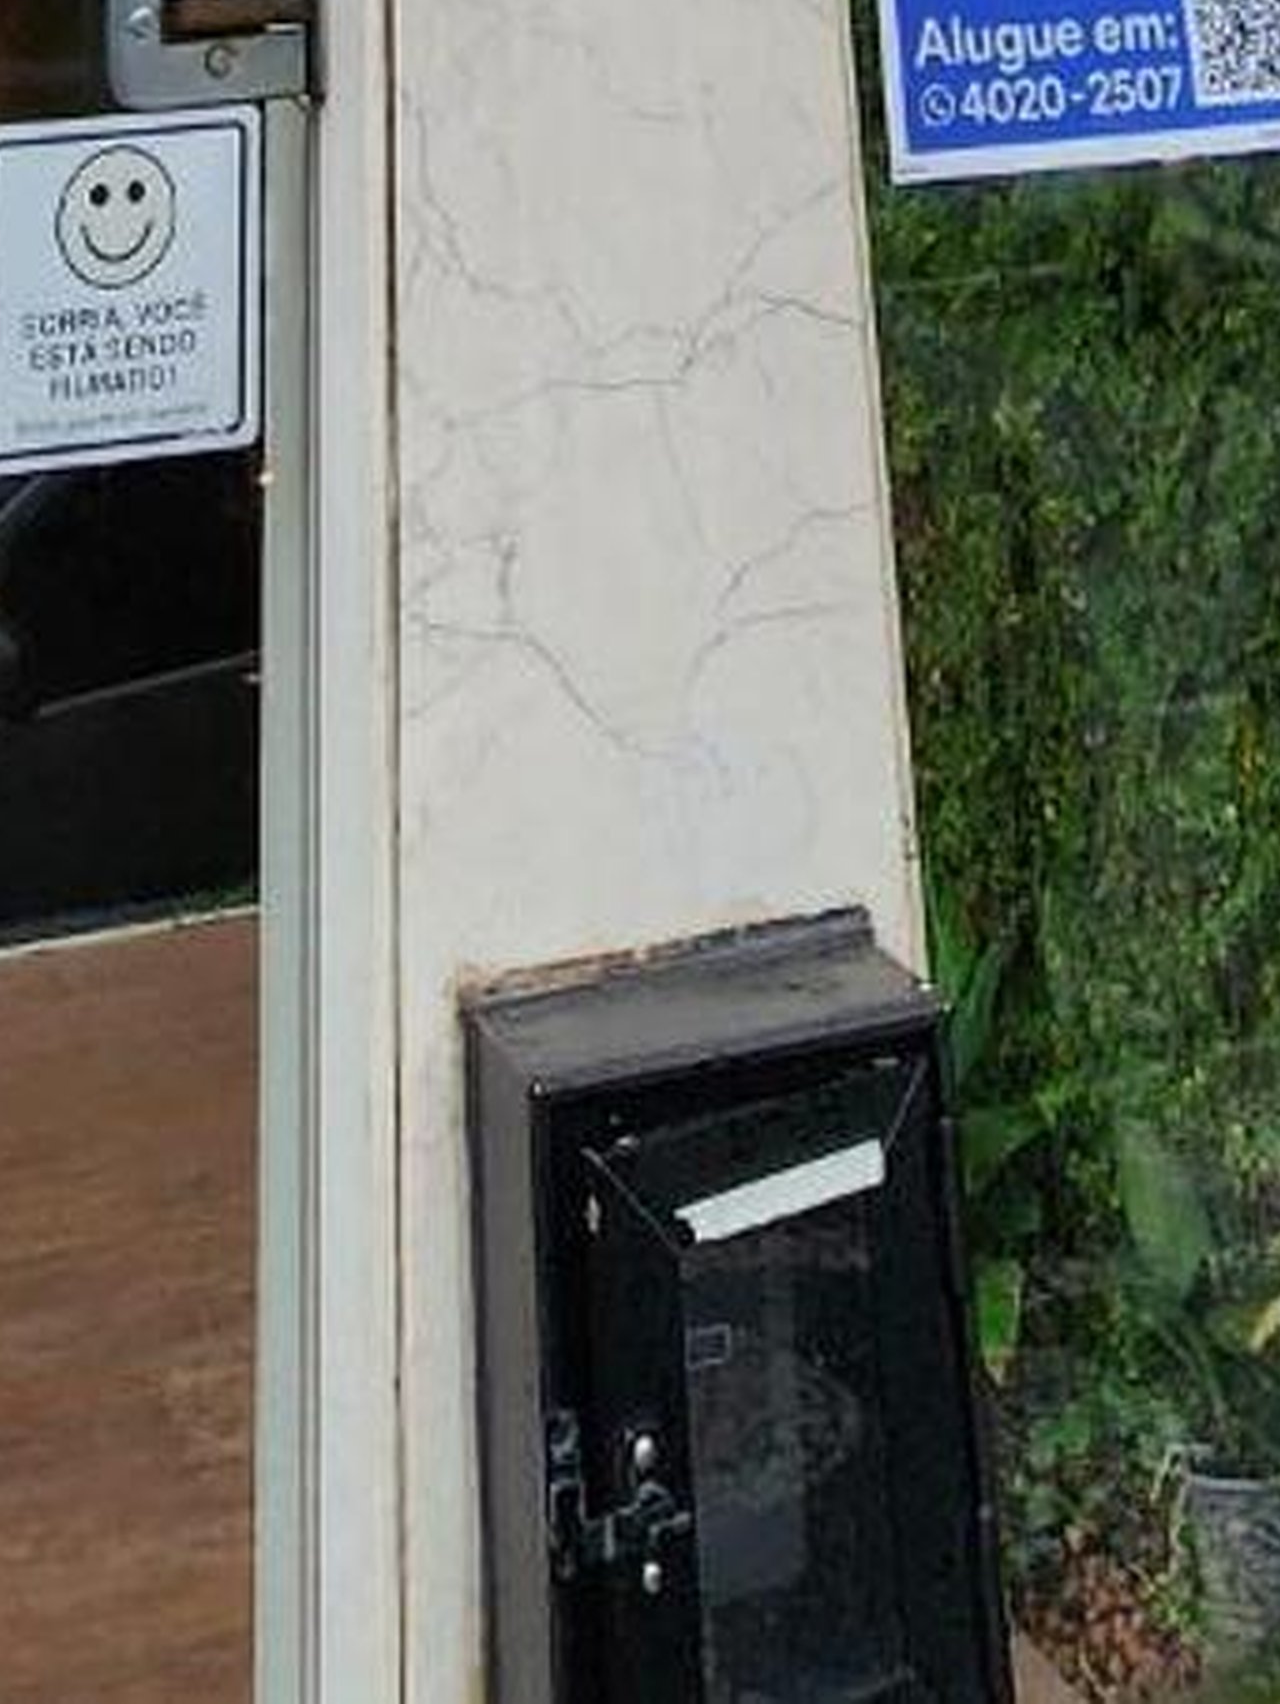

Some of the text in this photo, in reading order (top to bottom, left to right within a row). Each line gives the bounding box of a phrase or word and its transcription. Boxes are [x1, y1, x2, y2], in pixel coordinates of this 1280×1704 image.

[914, 12, 1180, 74] Alugue em:
[103, 328, 196, 360] SENDO
